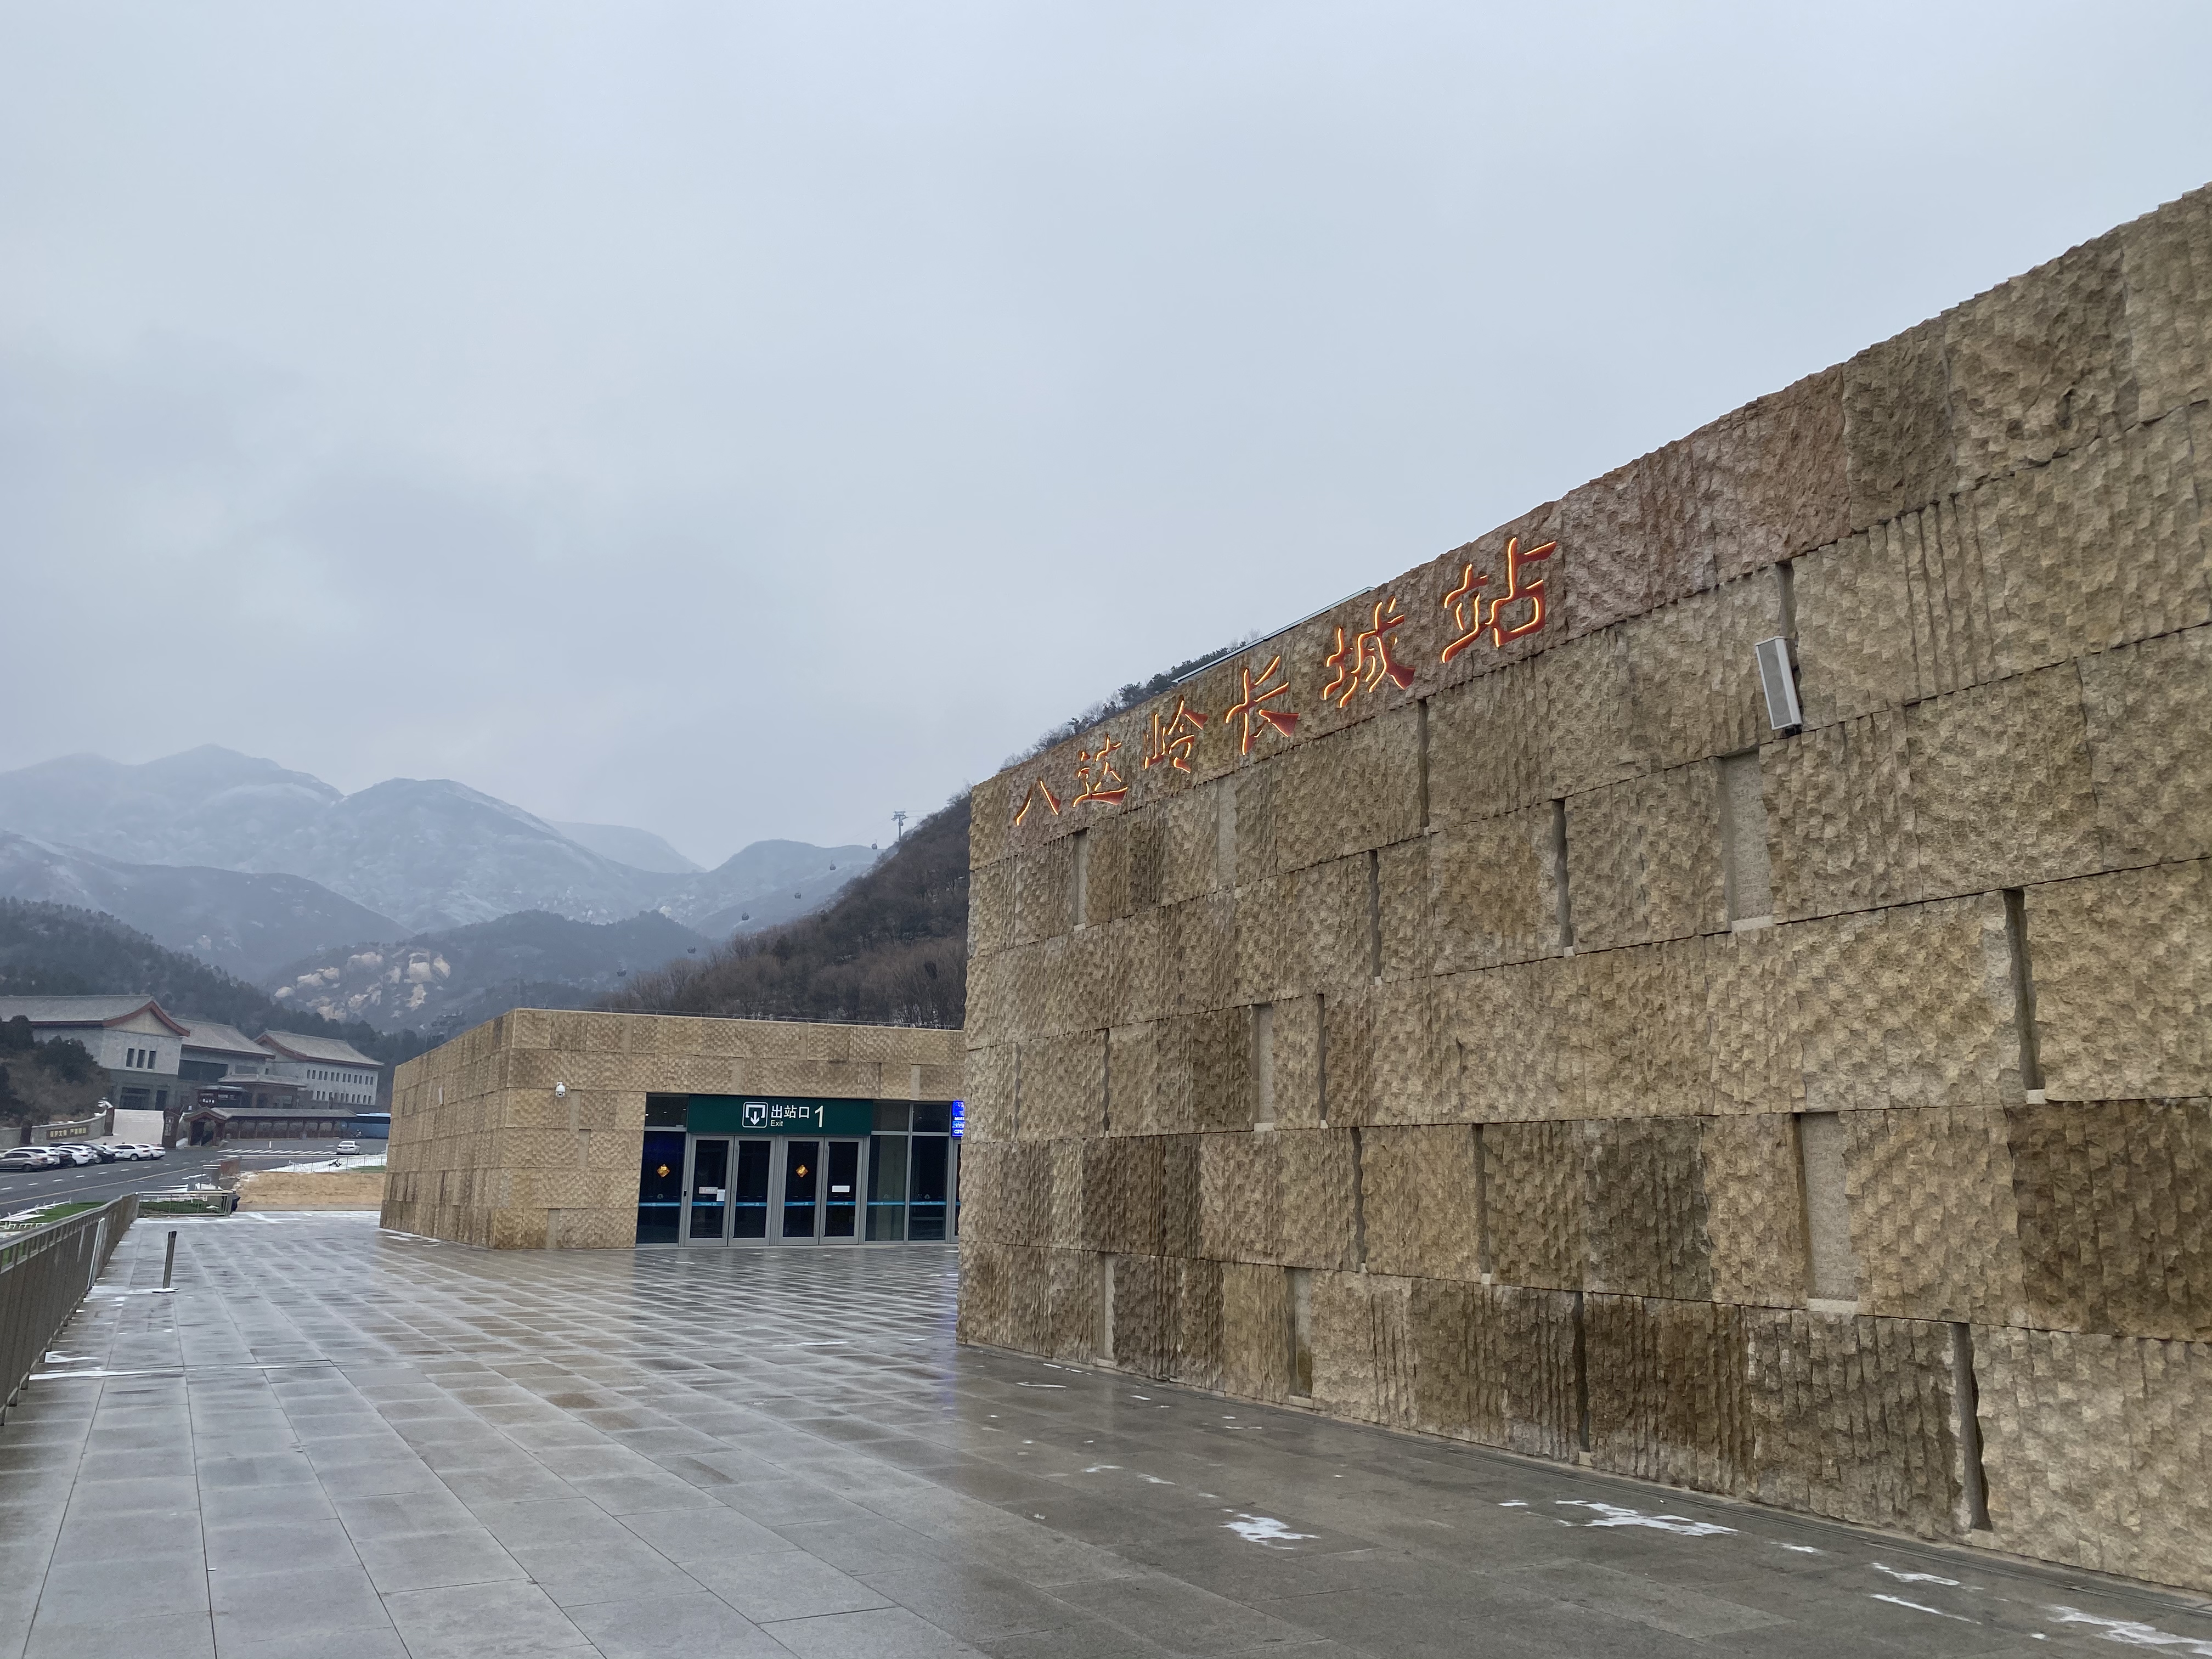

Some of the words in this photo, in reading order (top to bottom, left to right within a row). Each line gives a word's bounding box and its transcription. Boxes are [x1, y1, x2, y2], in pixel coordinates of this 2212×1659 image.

[1013, 537, 1558, 827] 八达岭长城站
[771, 1104, 810, 1119] 出站口
[815, 1105, 824, 1127] 1
